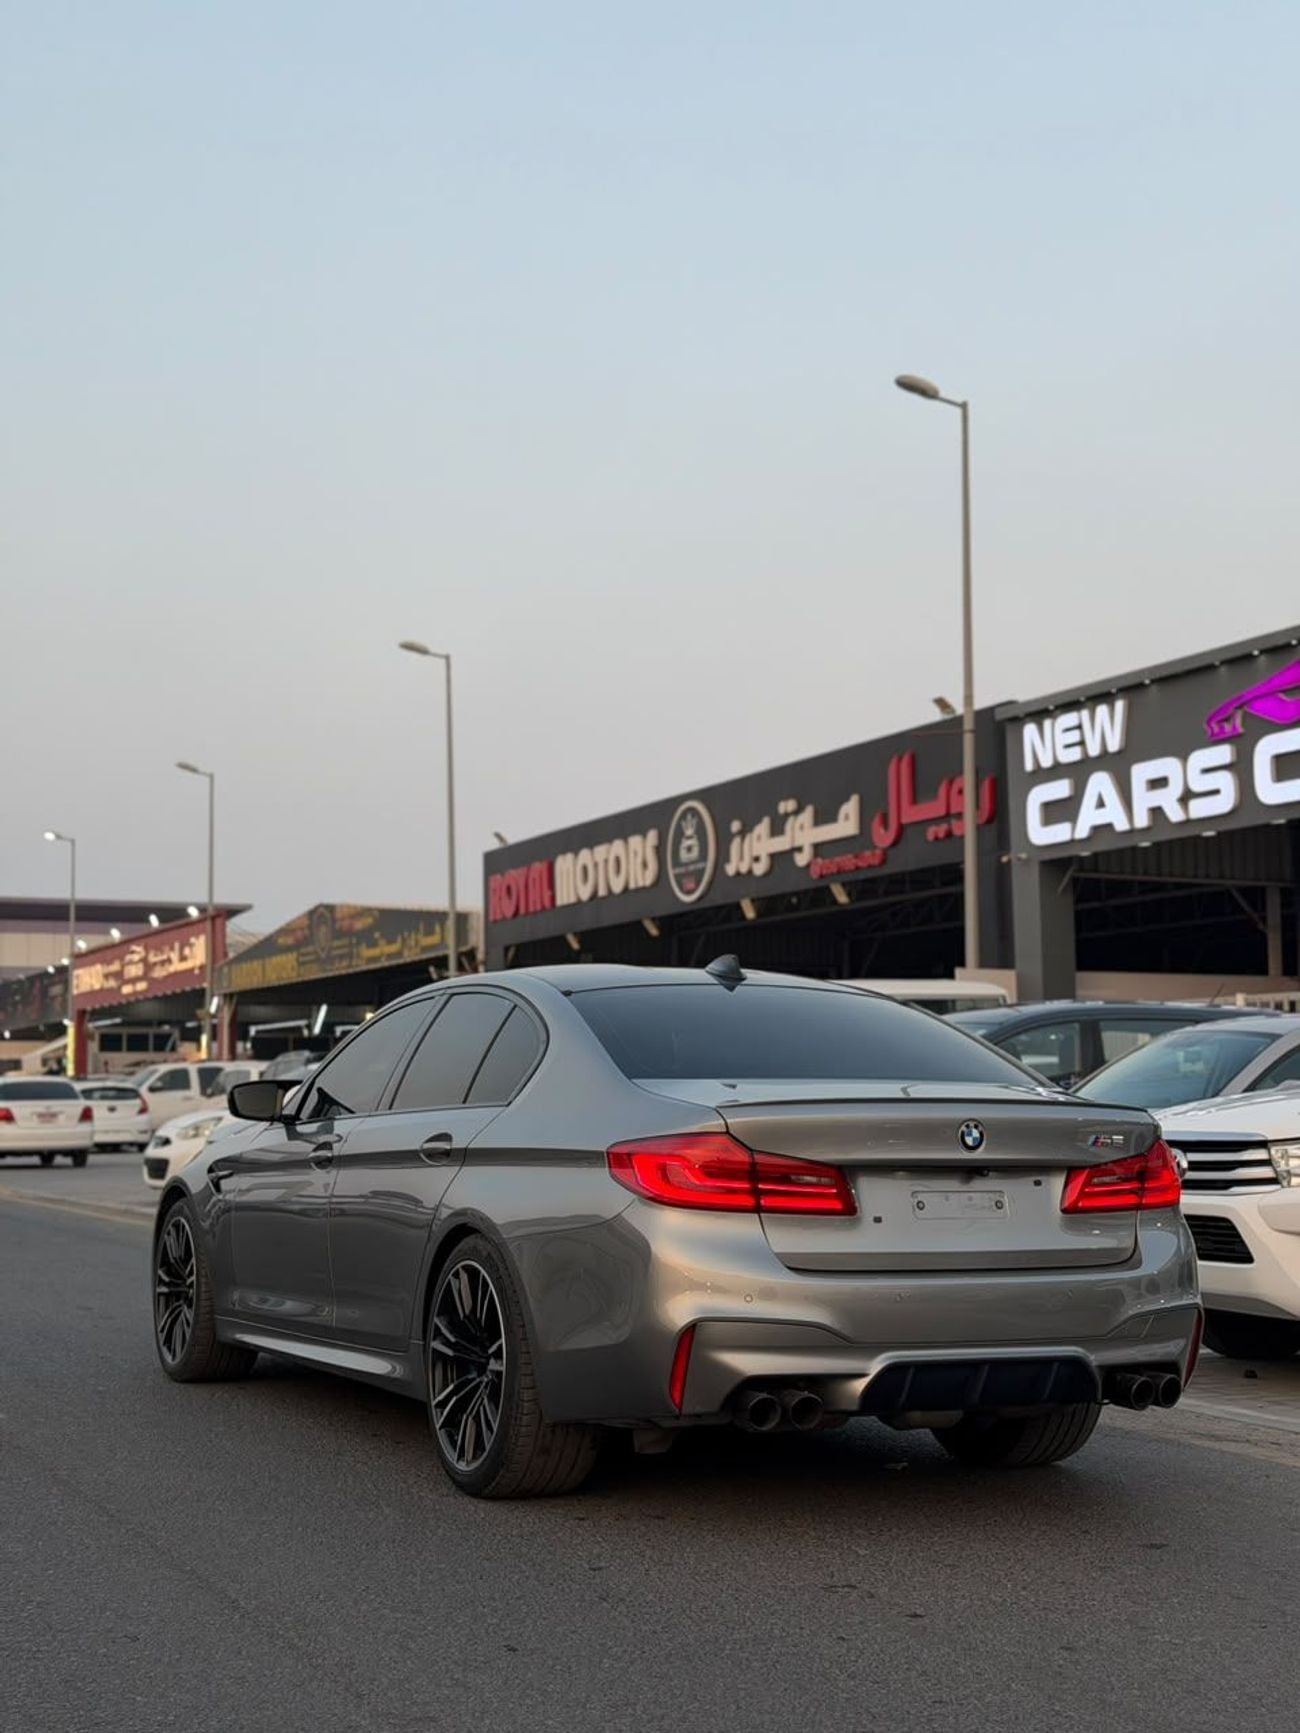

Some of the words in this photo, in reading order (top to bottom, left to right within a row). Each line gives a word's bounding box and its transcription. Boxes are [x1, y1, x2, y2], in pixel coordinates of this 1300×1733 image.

[1022, 699, 1125, 772] NEW
[726, 793, 861, 877] موتورز
[1026, 744, 1238, 846] CARS
[489, 859, 553, 922] ROYAL
[555, 828, 659, 907] MOTORS
